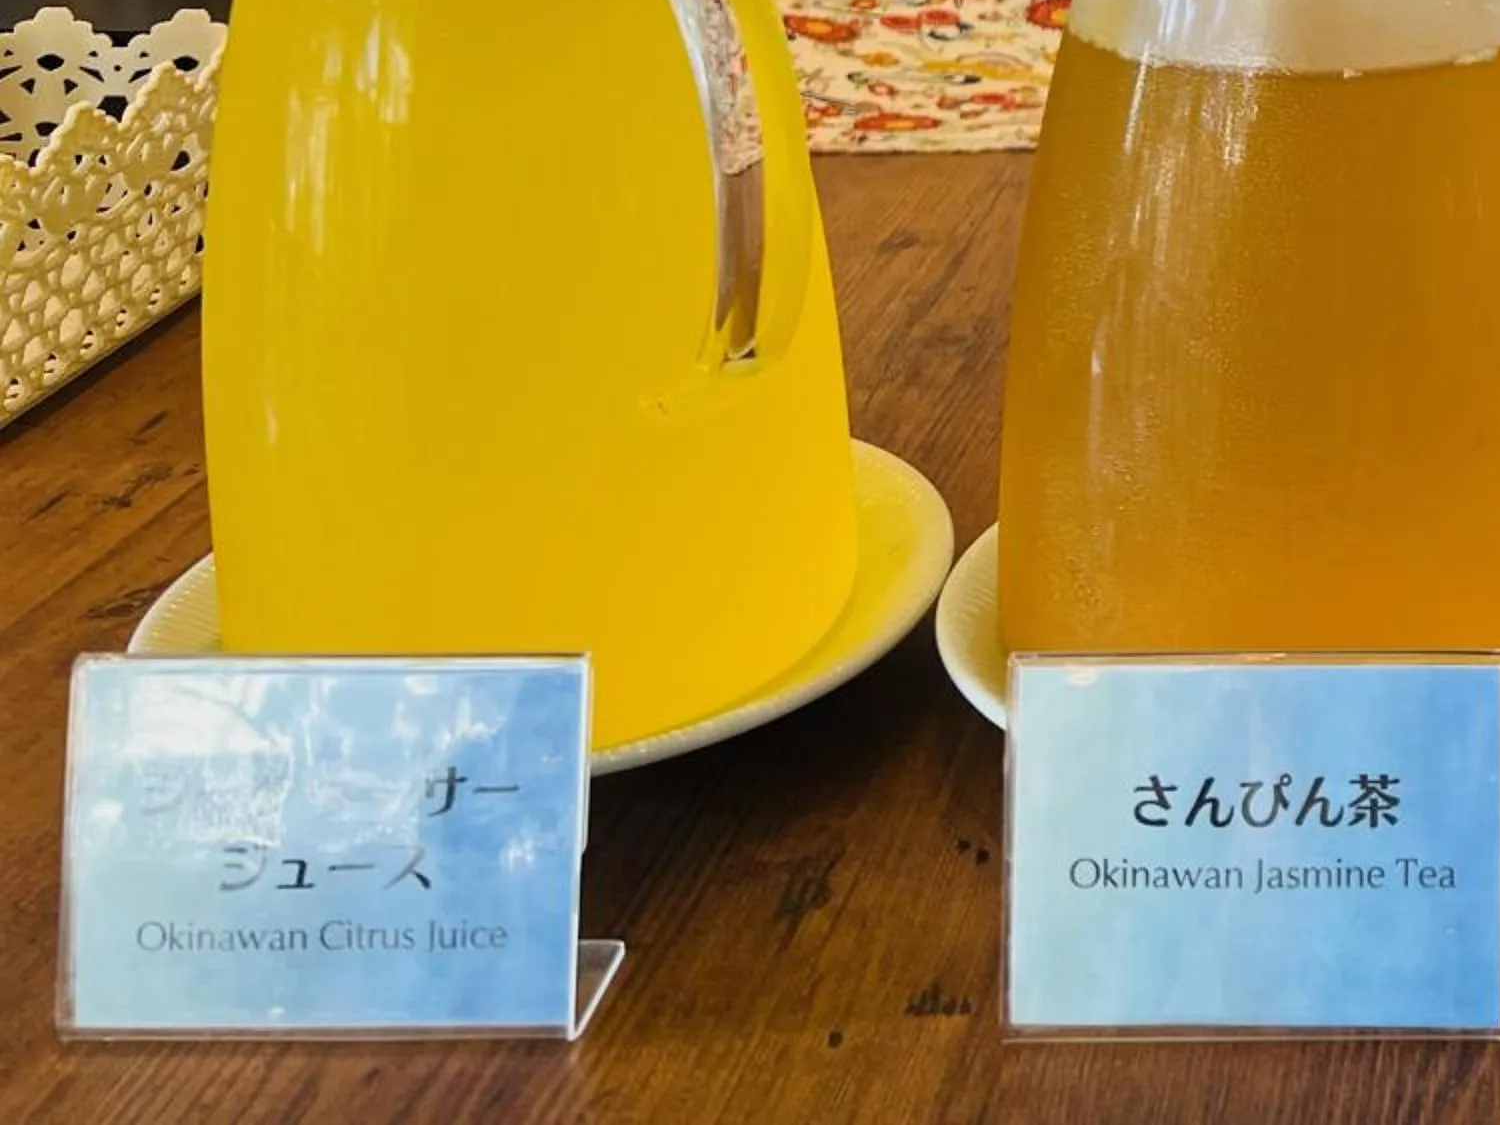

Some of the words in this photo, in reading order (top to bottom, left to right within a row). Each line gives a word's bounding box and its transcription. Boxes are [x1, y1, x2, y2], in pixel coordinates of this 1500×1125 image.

[1132, 773, 1401, 828] さんぴん茶
[218, 845, 432, 891] ジュース
[1069, 859, 1243, 890] Okinawan
[1253, 859, 1386, 894] Jasmine
[1395, 859, 1457, 889] Tea
[136, 921, 308, 952] Okinawan
[319, 920, 415, 950] Citrus
[428, 920, 508, 951] Juice
